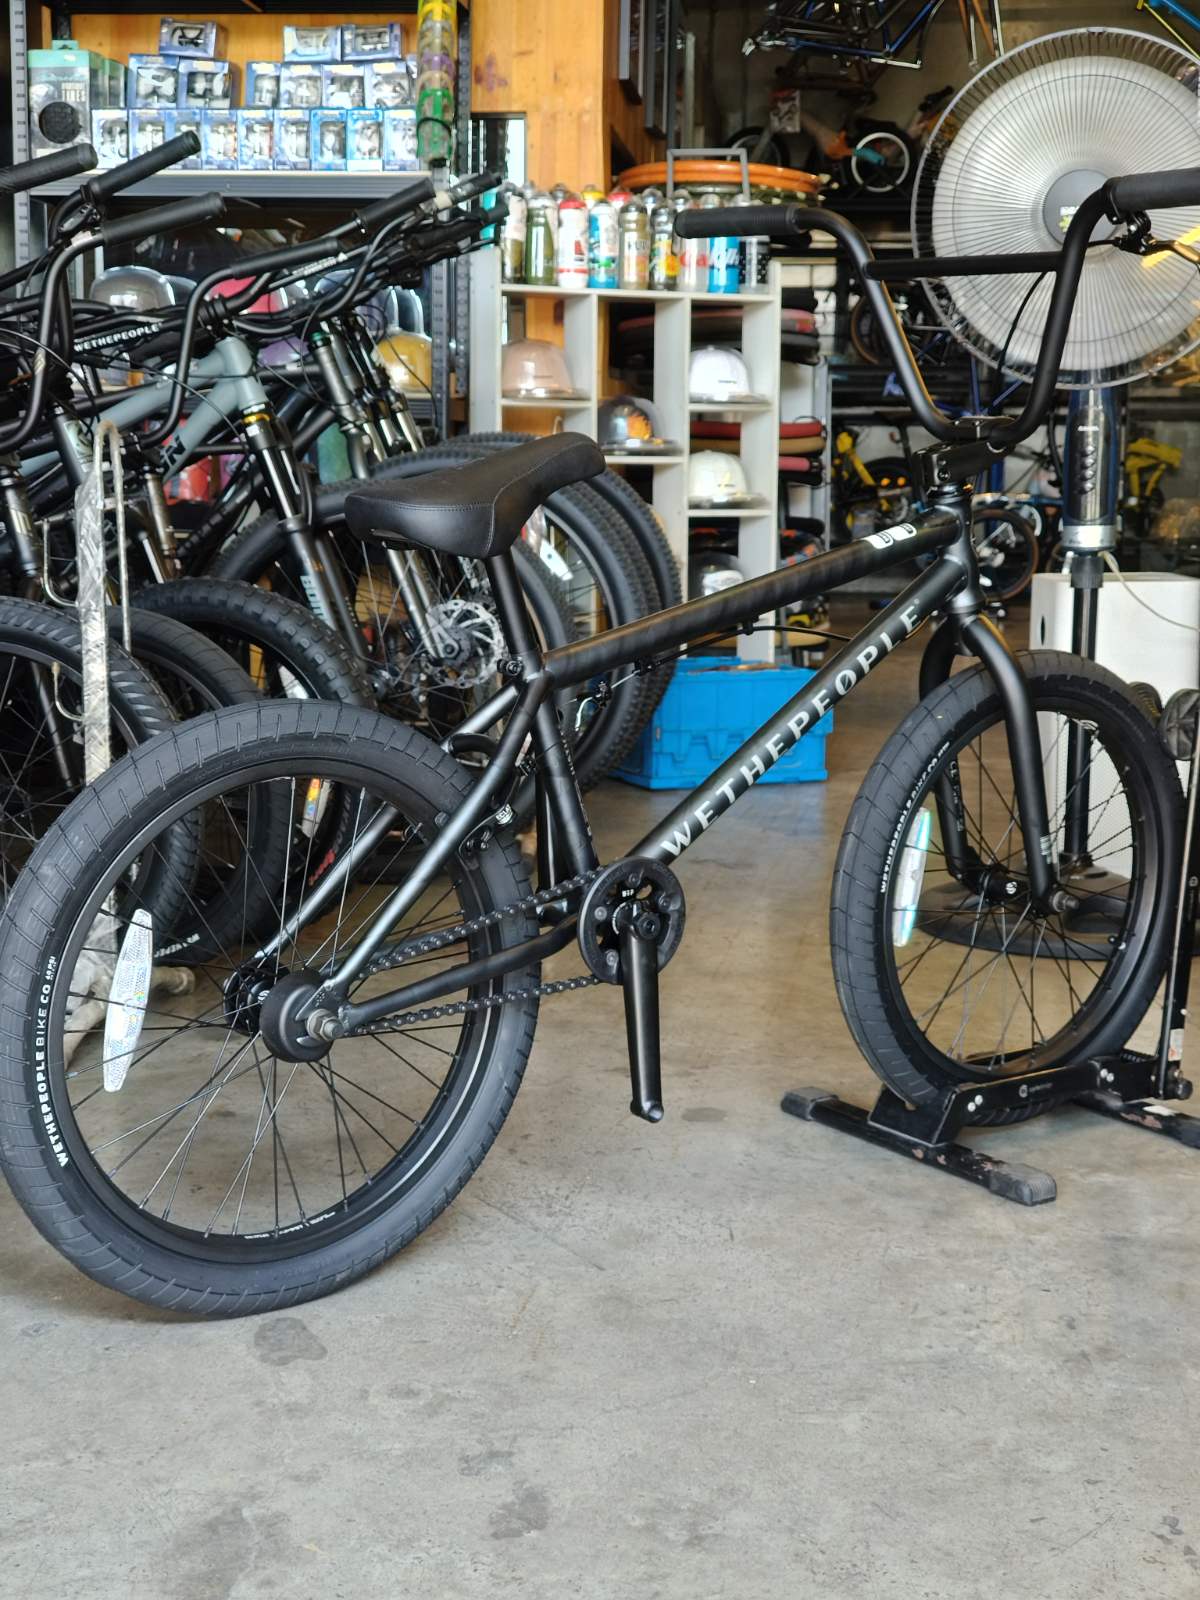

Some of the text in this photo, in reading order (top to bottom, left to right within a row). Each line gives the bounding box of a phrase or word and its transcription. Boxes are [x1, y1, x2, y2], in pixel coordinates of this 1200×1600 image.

[73, 323, 161, 352] WETHEPEOPLE
[660, 604, 920, 857] WETHEPEOPLE
[40, 984, 51, 1004] CO
[36, 1008, 48, 1047] BIKE
[36, 1050, 69, 1167] WETHEPEOPLE
